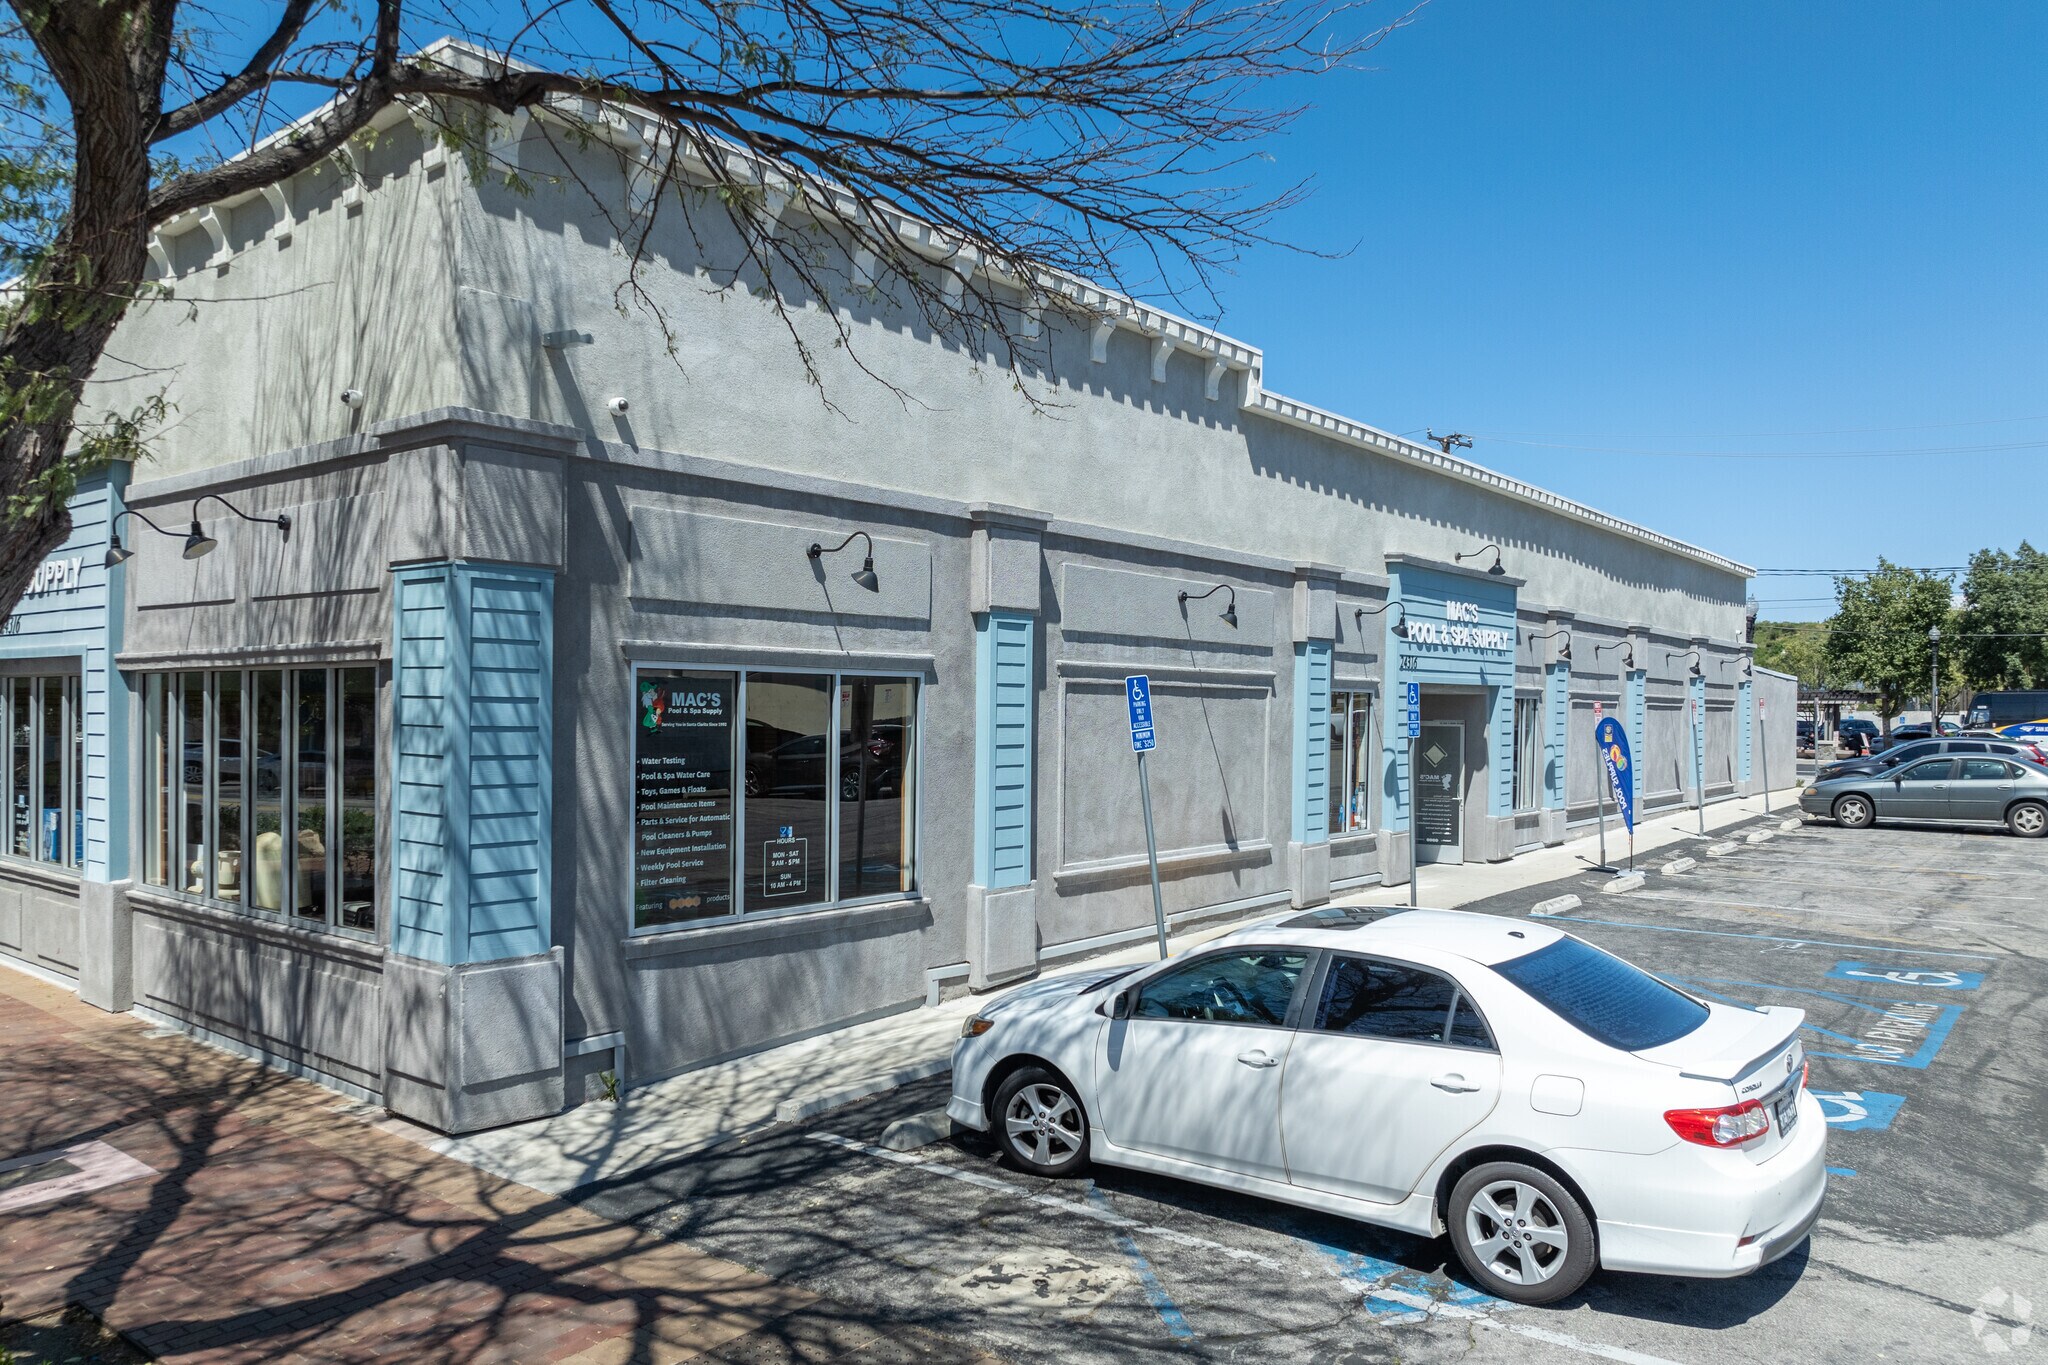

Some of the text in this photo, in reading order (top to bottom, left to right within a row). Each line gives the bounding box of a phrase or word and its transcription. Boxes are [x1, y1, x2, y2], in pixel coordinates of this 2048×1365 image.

[1446, 600, 1479, 623] MAC'S
[1408, 621, 1509, 650] POOL & SPA SUPPLY
[672, 692, 721, 707] MAC'S
[662, 757, 686, 765] Testing
[641, 772, 656, 780] Pool
[663, 772, 675, 780] Spa
[665, 816, 688, 824] Service
[689, 815, 698, 824] for
[699, 813, 730, 822] Automatic
[658, 831, 684, 840] Cleaners
[656, 846, 690, 855] Equipment
[692, 843, 726, 852] Installation
[641, 863, 665, 871] Weekly
[659, 876, 686, 885] Cleaning
[636, 902, 663, 910] Featuring
[706, 894, 731, 903] products
[1846, 1002, 1938, 1063] NO PARKING
